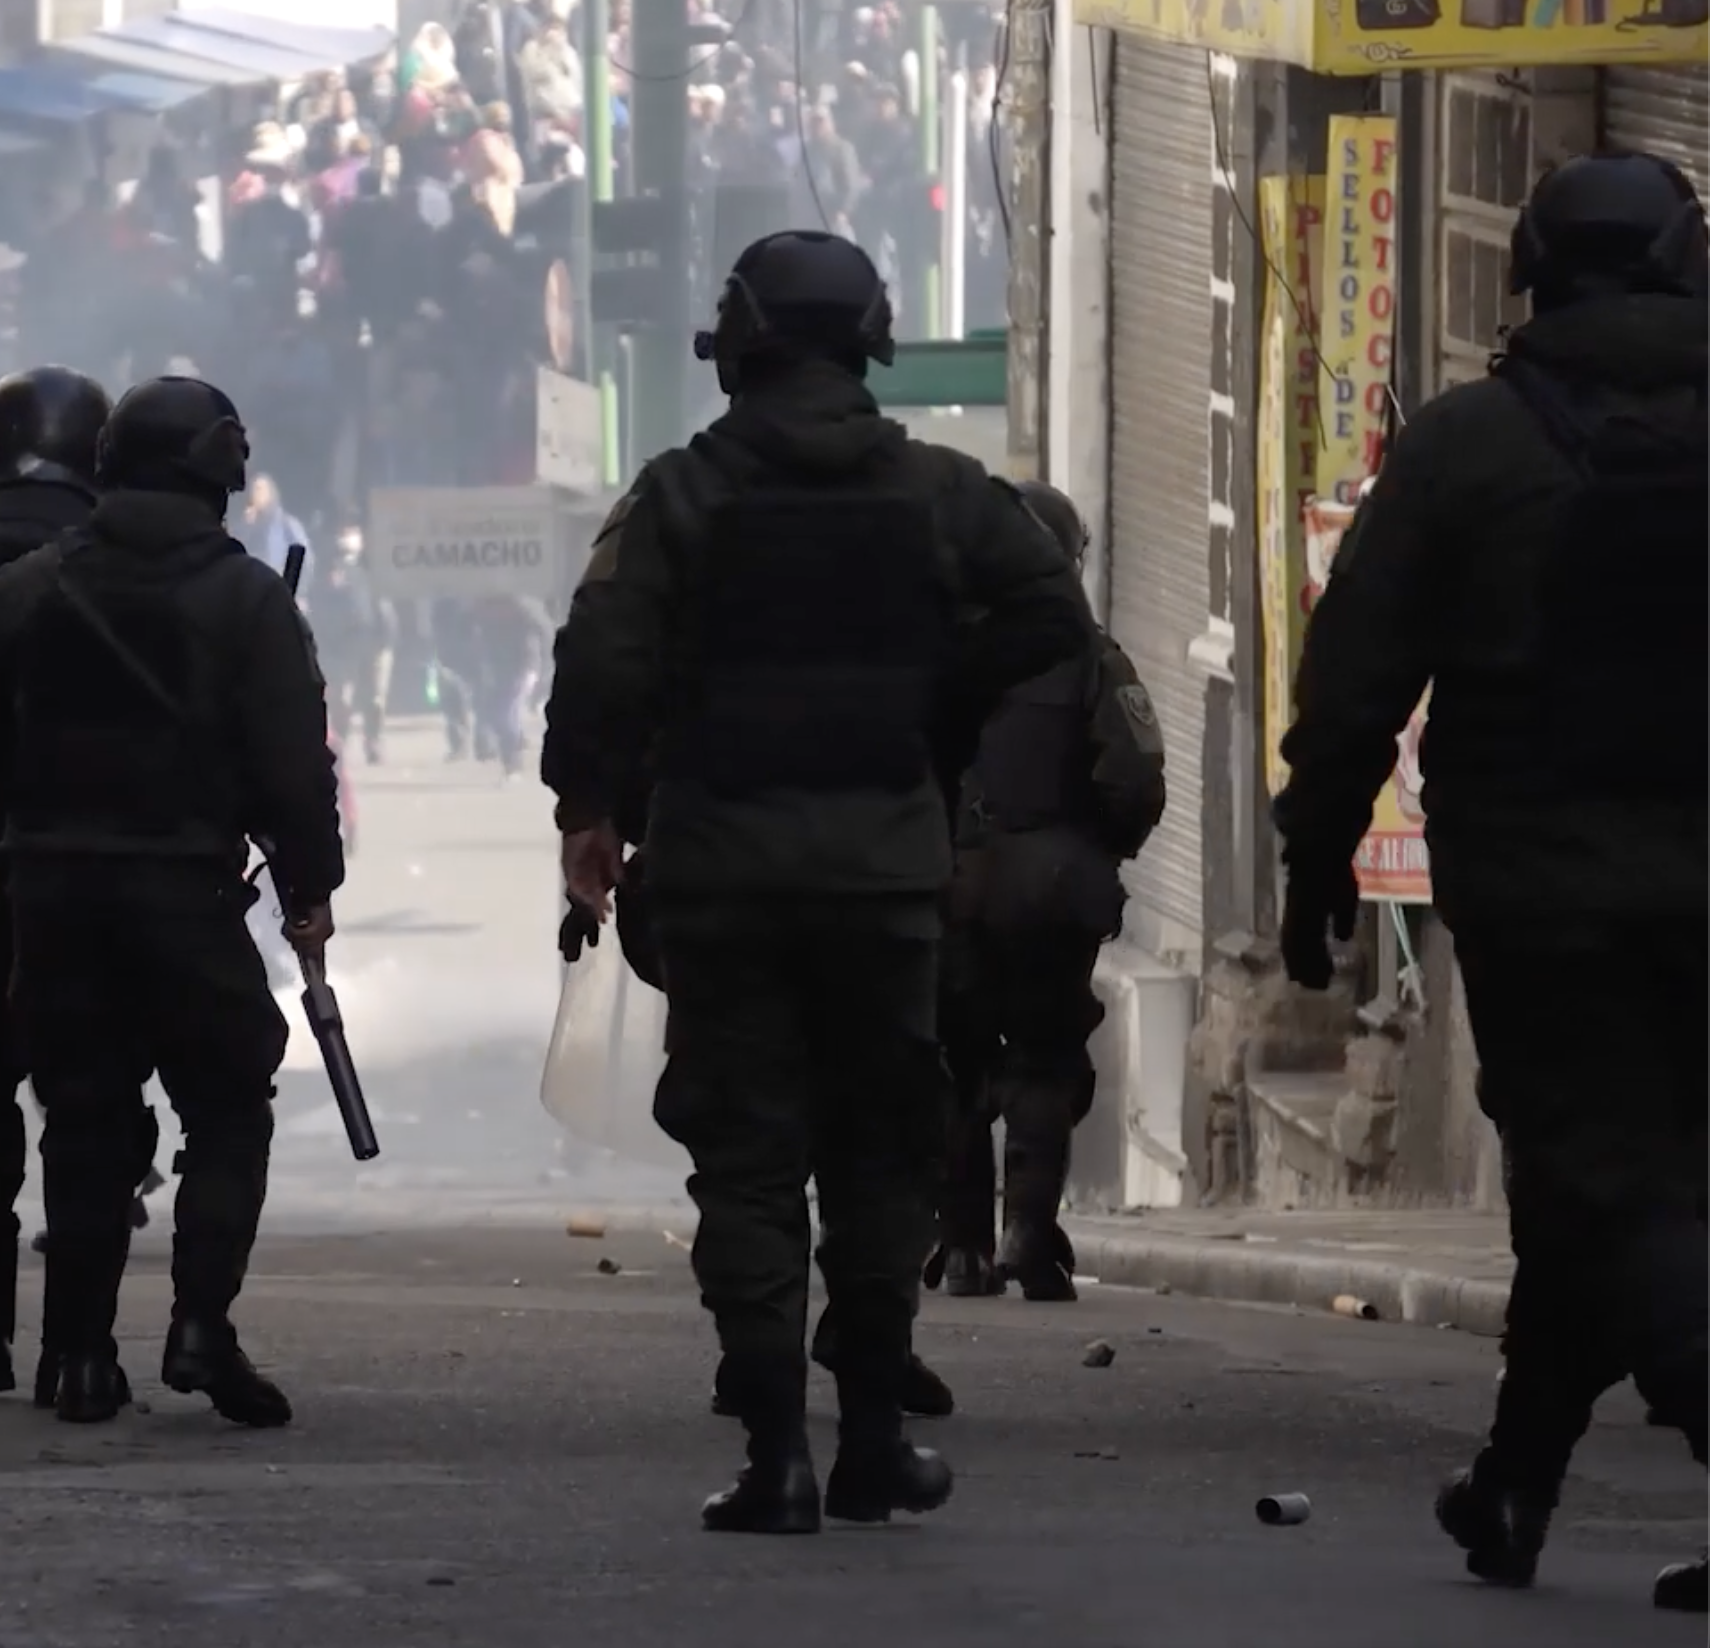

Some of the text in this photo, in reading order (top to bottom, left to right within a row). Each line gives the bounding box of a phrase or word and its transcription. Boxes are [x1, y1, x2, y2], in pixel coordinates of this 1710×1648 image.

[1335, 138, 1360, 438] SELLOS DE
[391, 538, 544, 569] CAMACHO
